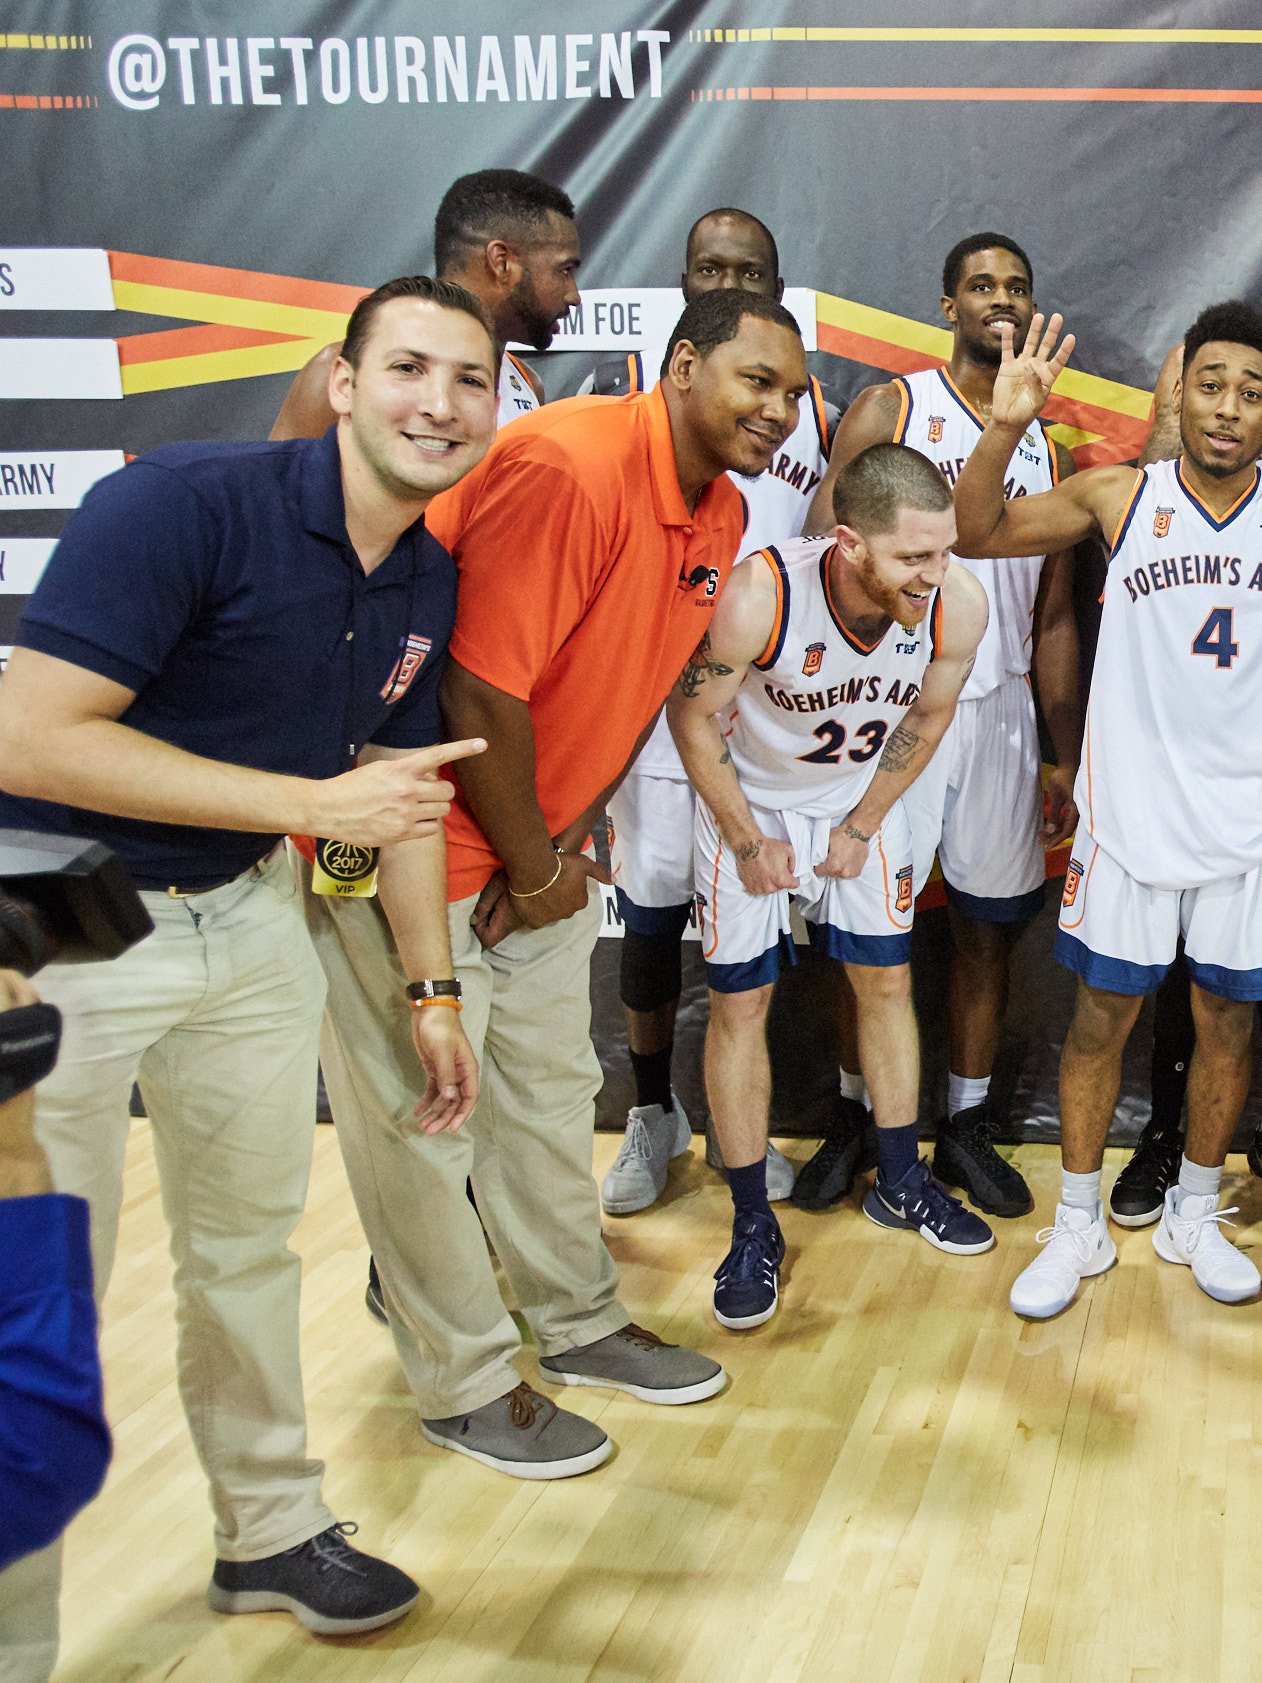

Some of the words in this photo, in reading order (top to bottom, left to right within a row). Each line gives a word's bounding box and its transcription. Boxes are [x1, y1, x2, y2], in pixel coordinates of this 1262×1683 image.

[108, 30, 672, 110] @THETOURNAMENT
[594, 302, 642, 335] FOE
[0, 462, 56, 496] RMY
[705, 566, 720, 598] S
[1122, 554, 1243, 604] BOEHEIM'S
[1190, 605, 1240, 670] 4
[795, 718, 889, 765] 23
[331, 856, 364, 871] 2017
[336, 884, 356, 895] VIP
